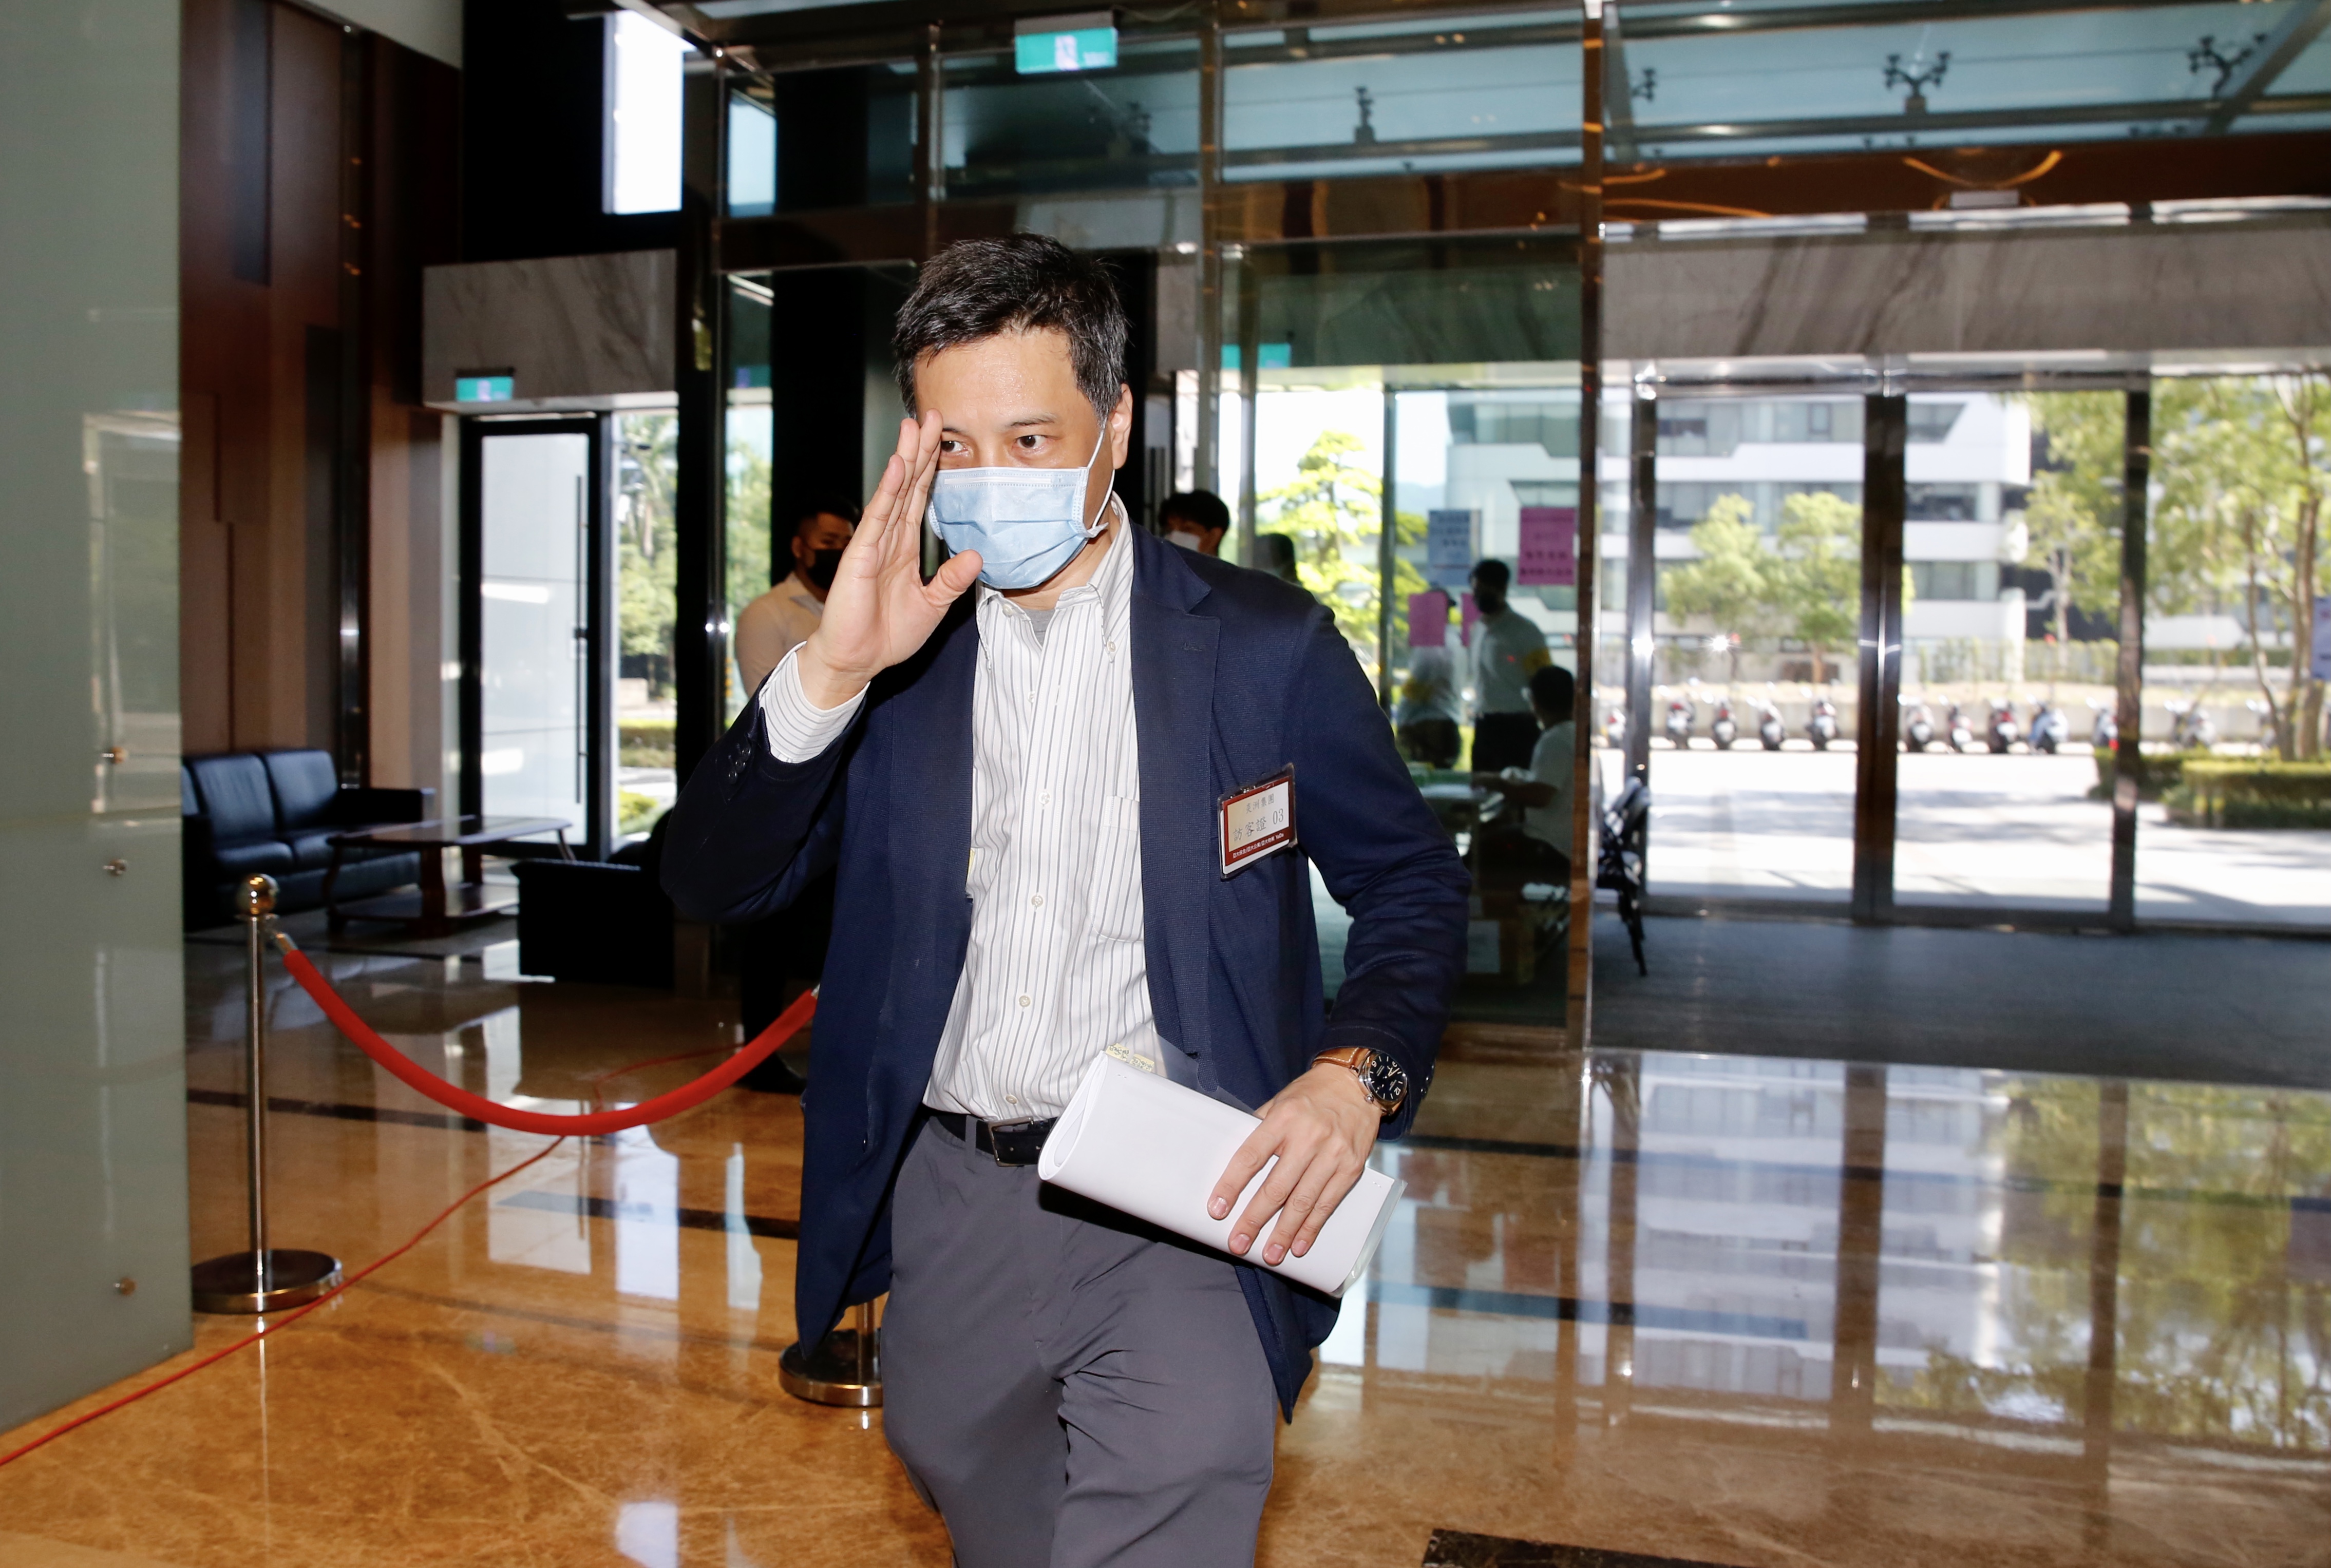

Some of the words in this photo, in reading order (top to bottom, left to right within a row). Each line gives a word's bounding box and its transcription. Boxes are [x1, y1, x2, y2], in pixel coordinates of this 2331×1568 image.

[1233, 816, 1267, 841] 訪客證
[1273, 808, 1284, 825] 03
